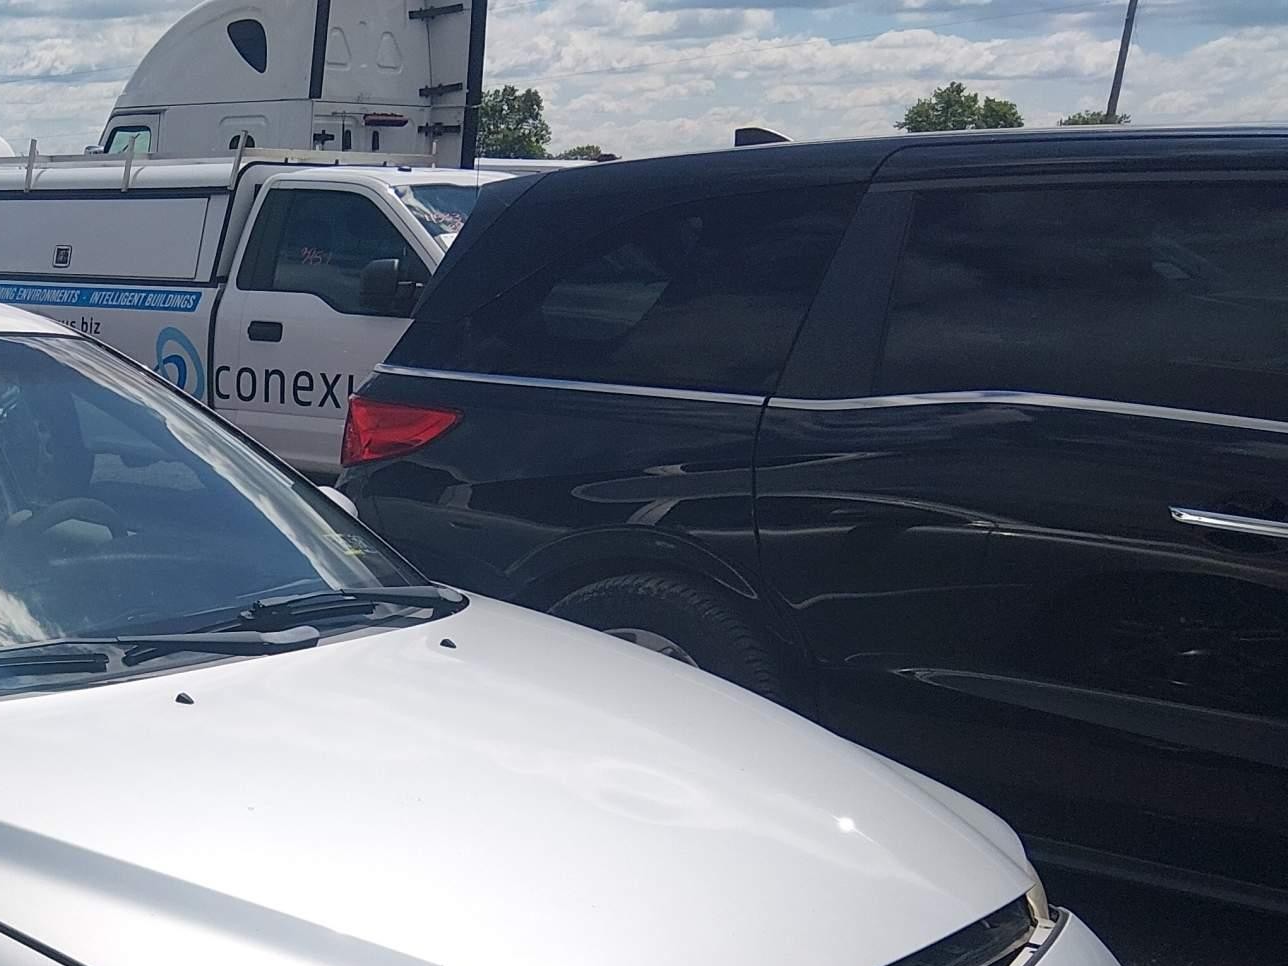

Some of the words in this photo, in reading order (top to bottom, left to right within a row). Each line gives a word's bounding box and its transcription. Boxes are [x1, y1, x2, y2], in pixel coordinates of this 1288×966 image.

[16, 287, 81, 303] ENVIRONMENTS
[89, 291, 146, 306] INTELLIGENT
[144, 293, 196, 309] BUILDINGS
[215, 365, 354, 409] conex
